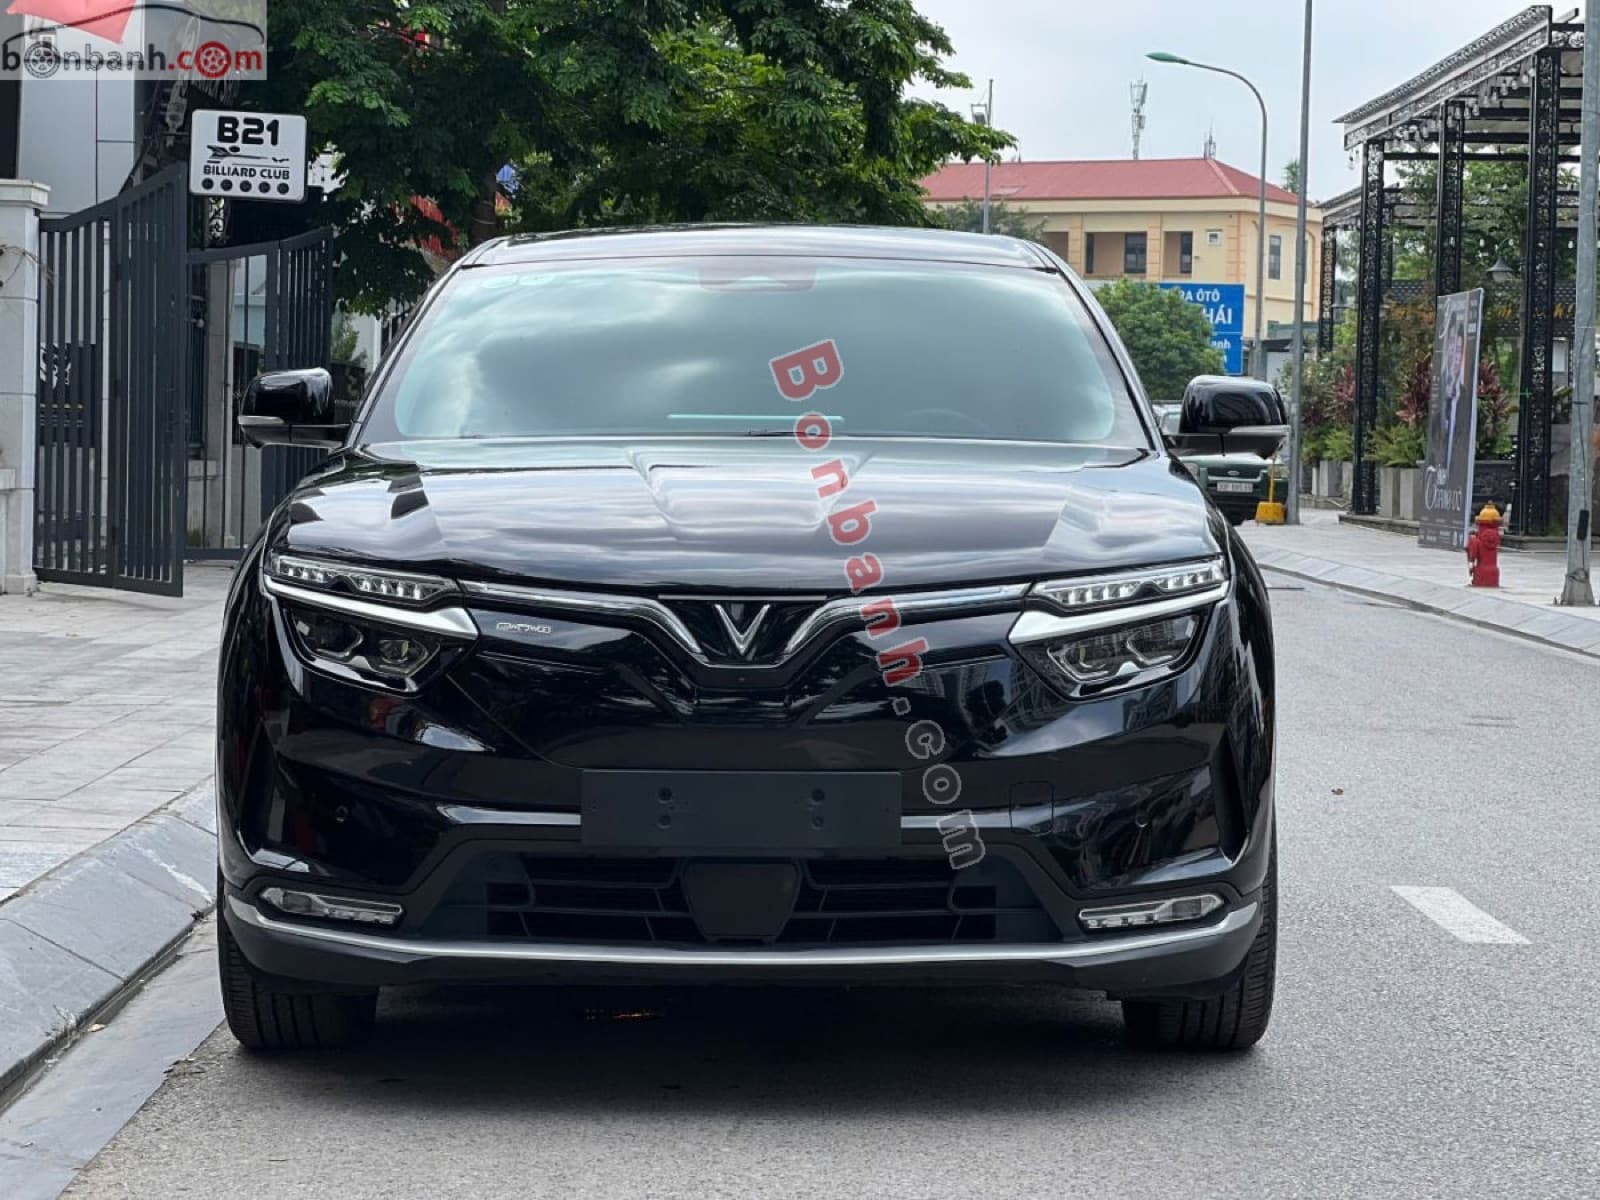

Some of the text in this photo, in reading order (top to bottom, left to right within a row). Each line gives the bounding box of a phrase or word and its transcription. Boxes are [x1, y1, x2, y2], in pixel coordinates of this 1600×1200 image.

[217, 116, 279, 146] B21
[204, 165, 290, 180] BILLIARD CLUB
[1196, 288, 1221, 303] ÔTÔ
